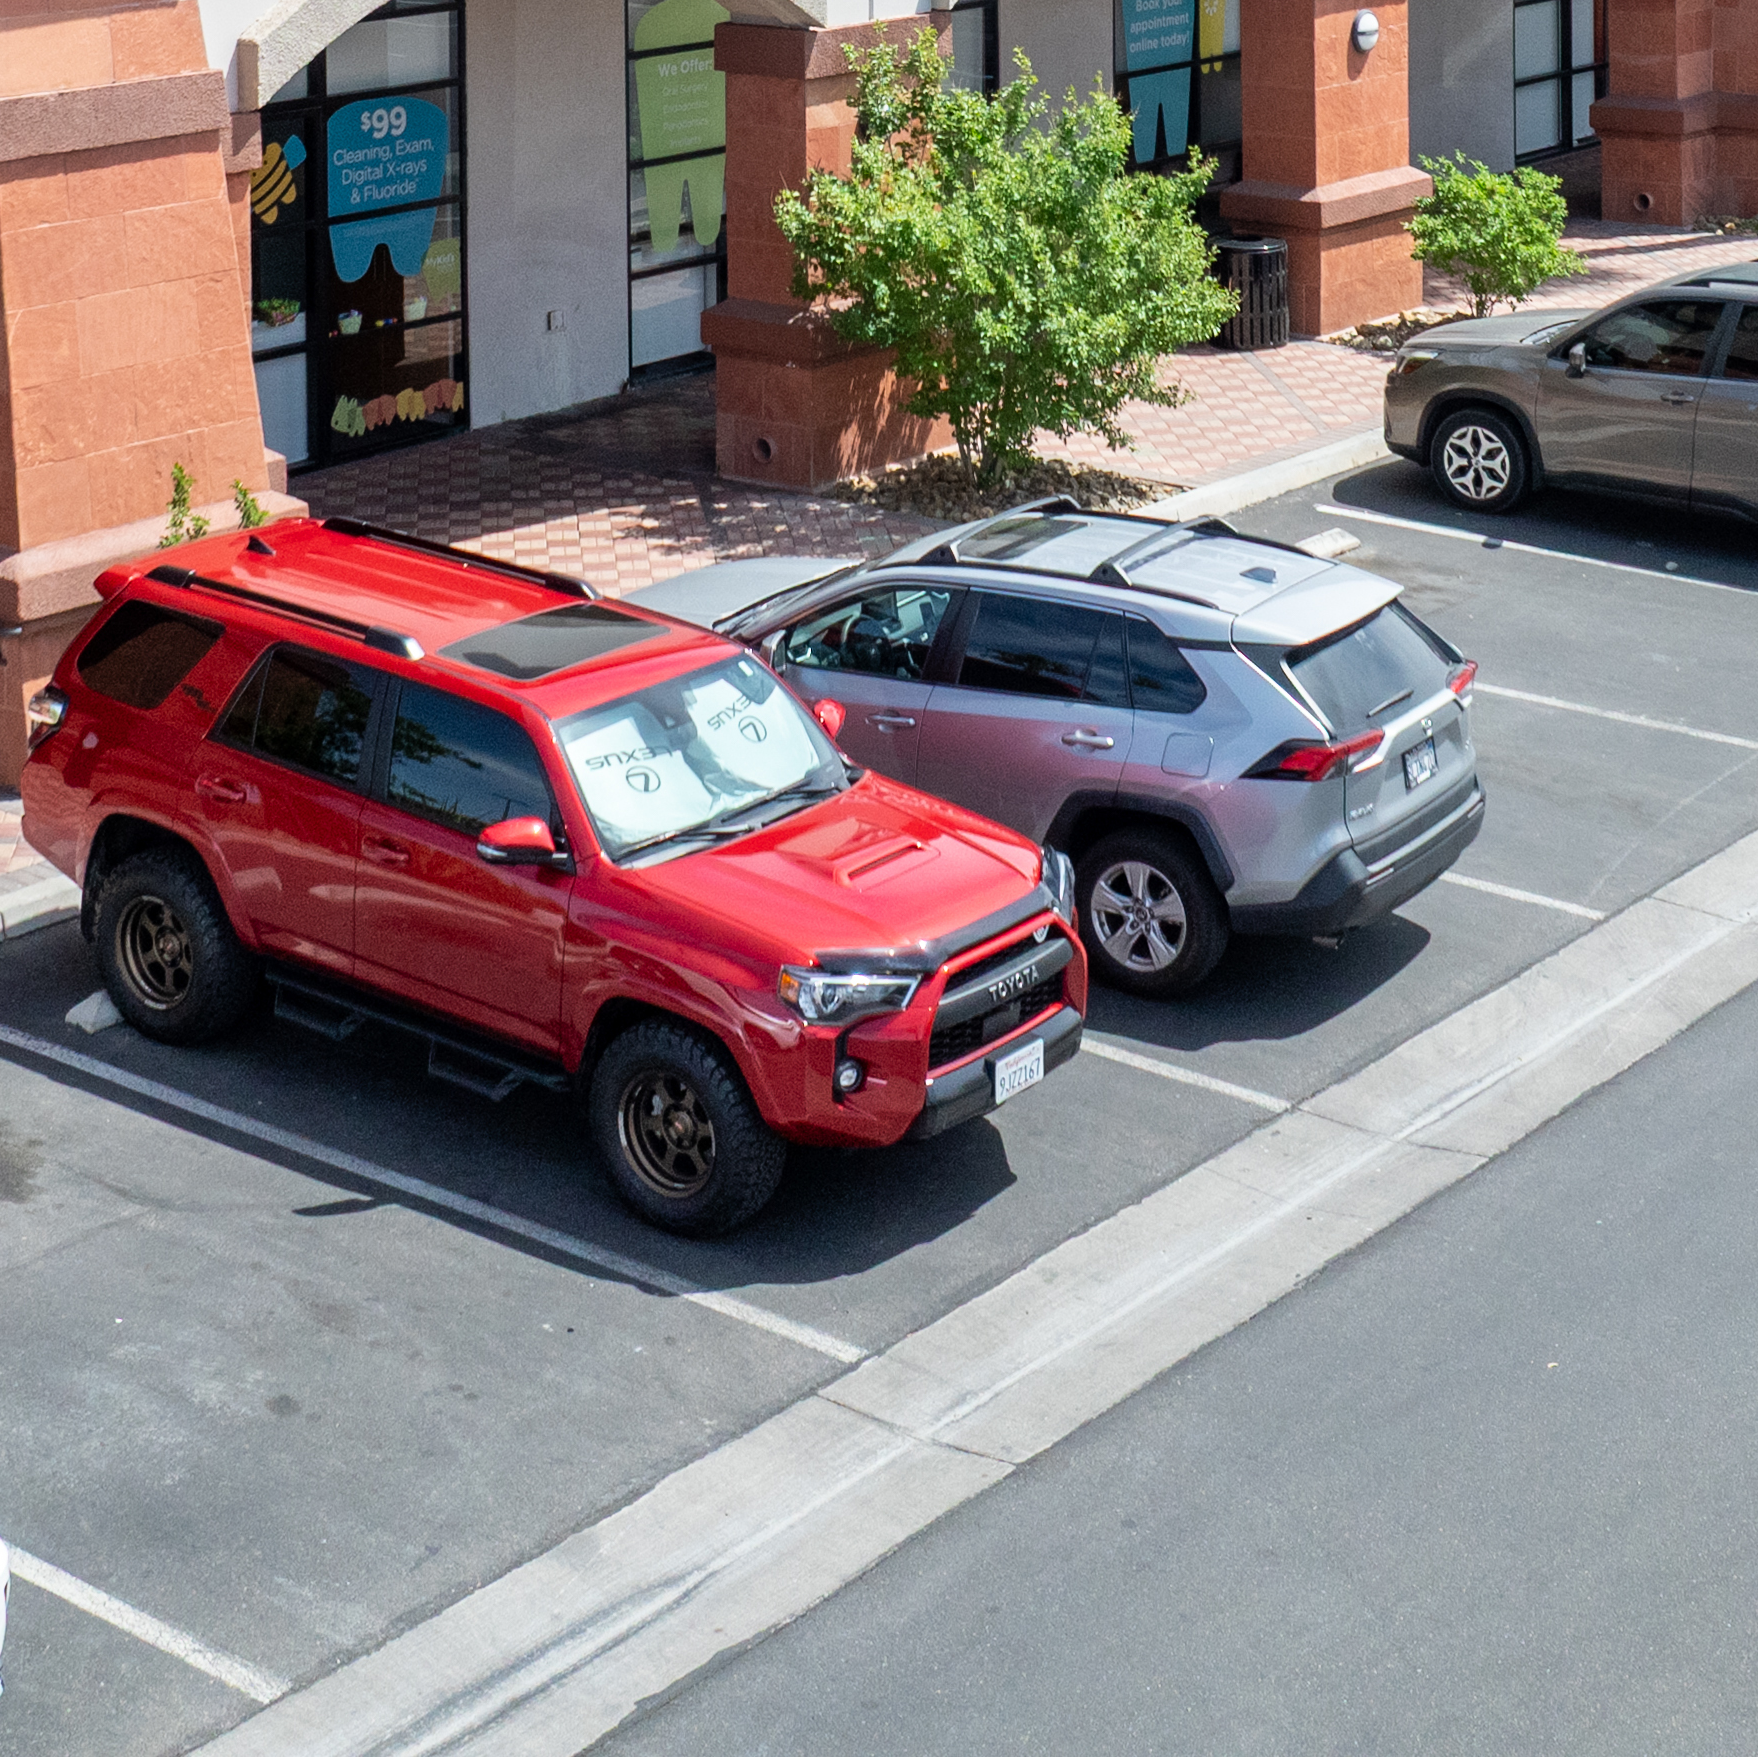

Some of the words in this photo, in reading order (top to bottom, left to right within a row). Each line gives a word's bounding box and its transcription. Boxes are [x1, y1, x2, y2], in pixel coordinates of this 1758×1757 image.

[1130, 12, 1189, 34] appointment
[1129, 37, 1158, 53] online
[658, 63, 678, 78] We
[360, 105, 408, 139] $99
[333, 144, 393, 166] Cleaning,
[395, 138, 435, 157] Exam,
[341, 163, 383, 186] Digital
[385, 158, 428, 178] X-rays
[350, 187, 362, 204] &
[707, 692, 752, 731] EXUS
[988, 964, 1040, 1003] TOYOTA
